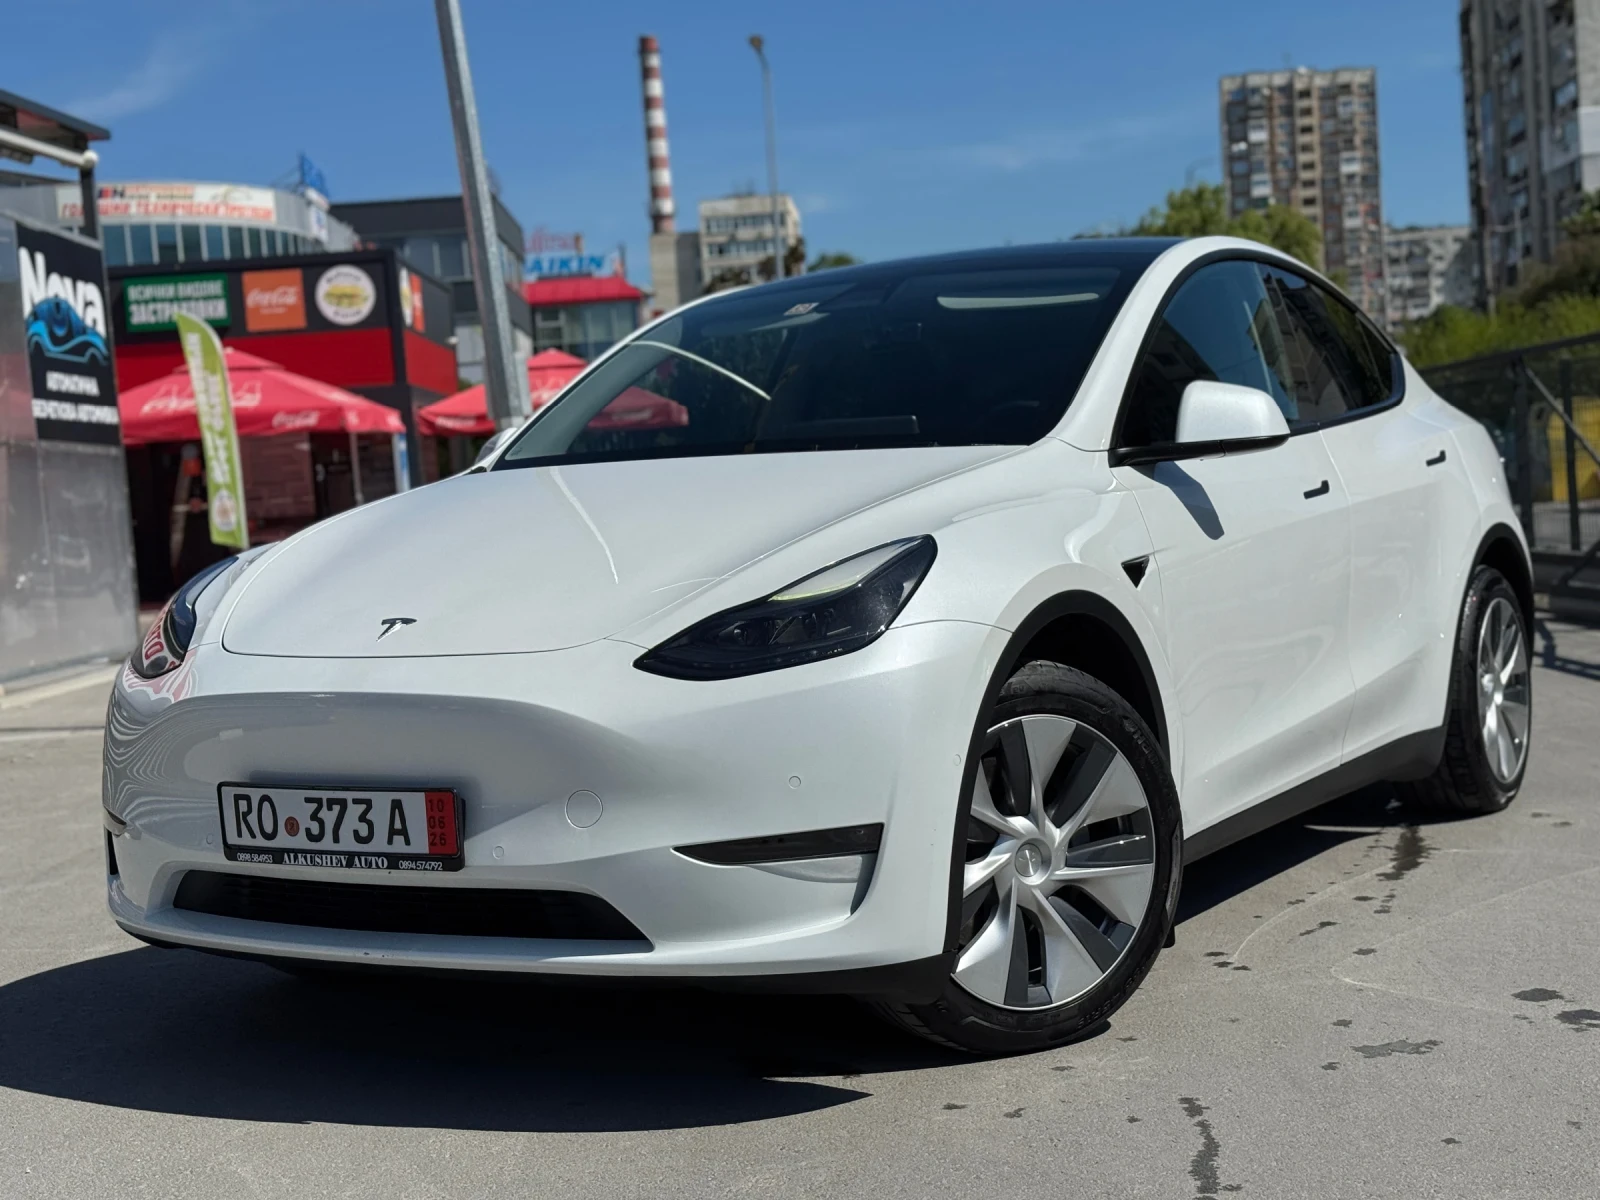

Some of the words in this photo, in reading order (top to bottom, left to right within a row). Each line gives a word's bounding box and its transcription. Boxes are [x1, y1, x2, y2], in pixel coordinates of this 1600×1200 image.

[524, 256, 605, 274] AIKIN
[428, 798, 445, 813] 10
[233, 793, 279, 841] RO
[304, 796, 375, 845] 373
[386, 798, 411, 846] A
[428, 815, 446, 830] 06
[429, 832, 447, 847] 26
[282, 852, 348, 868] ALKUSHEV
[352, 855, 388, 869] AUTO
